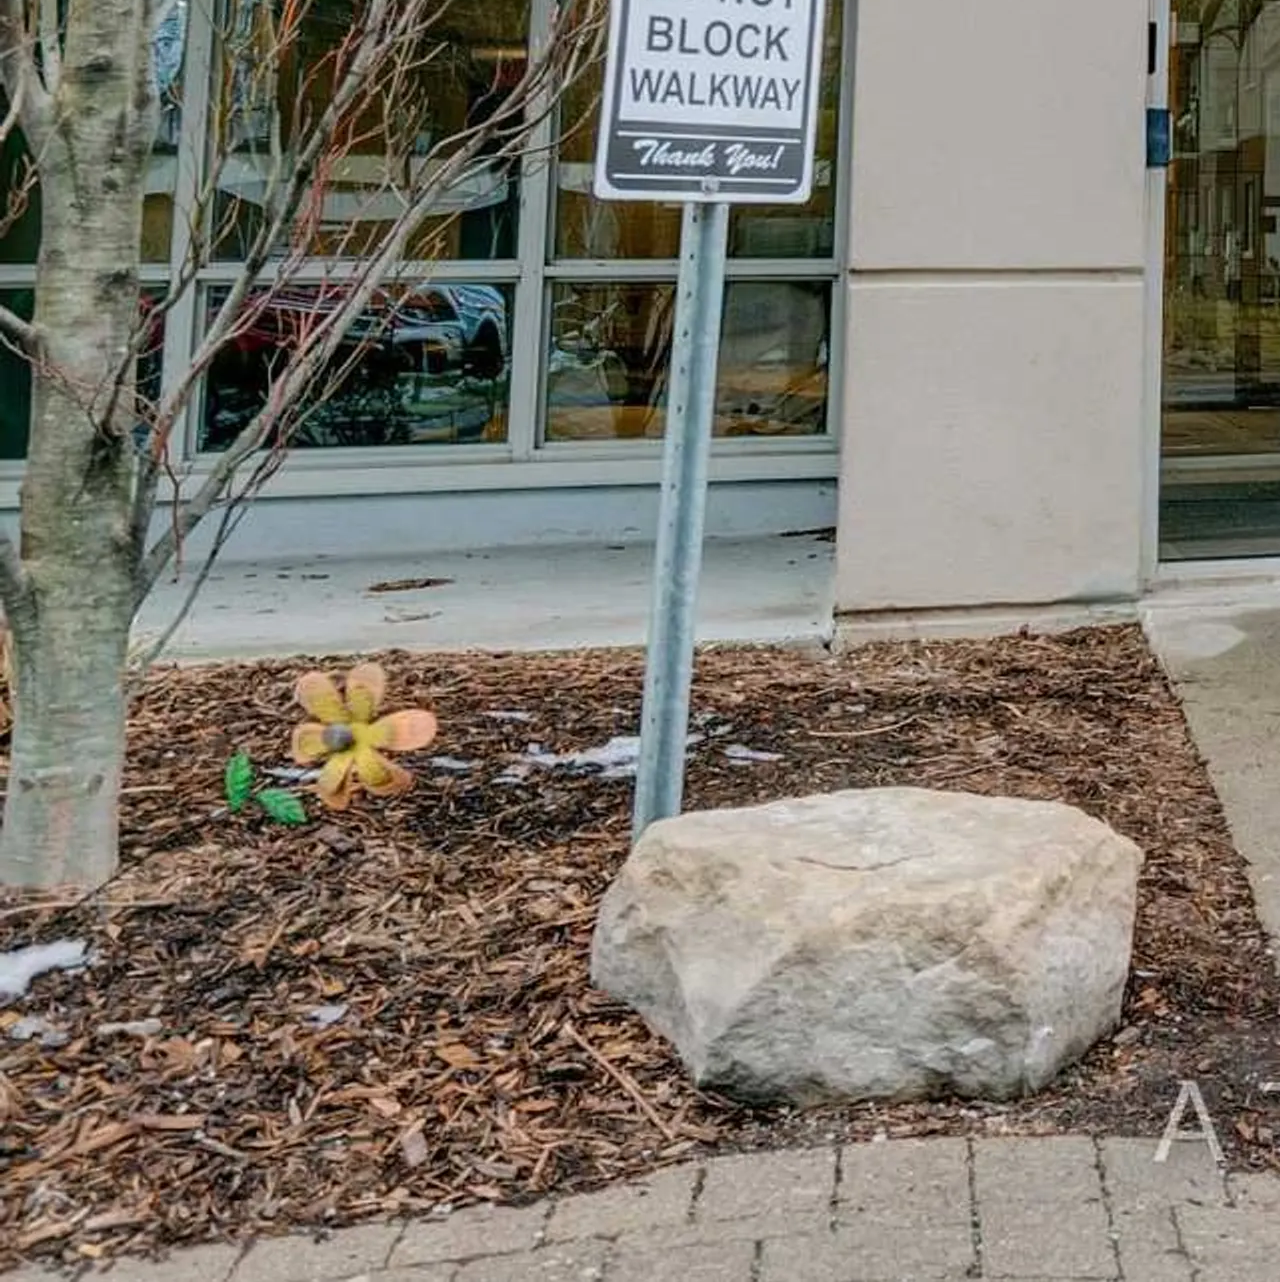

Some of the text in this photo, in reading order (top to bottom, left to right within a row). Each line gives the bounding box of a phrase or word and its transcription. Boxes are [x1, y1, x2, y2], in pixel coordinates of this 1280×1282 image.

[645, 15, 790, 62] BLOCK
[630, 68, 802, 112] WALKWAY
[632, 138, 785, 176] Thank You!
